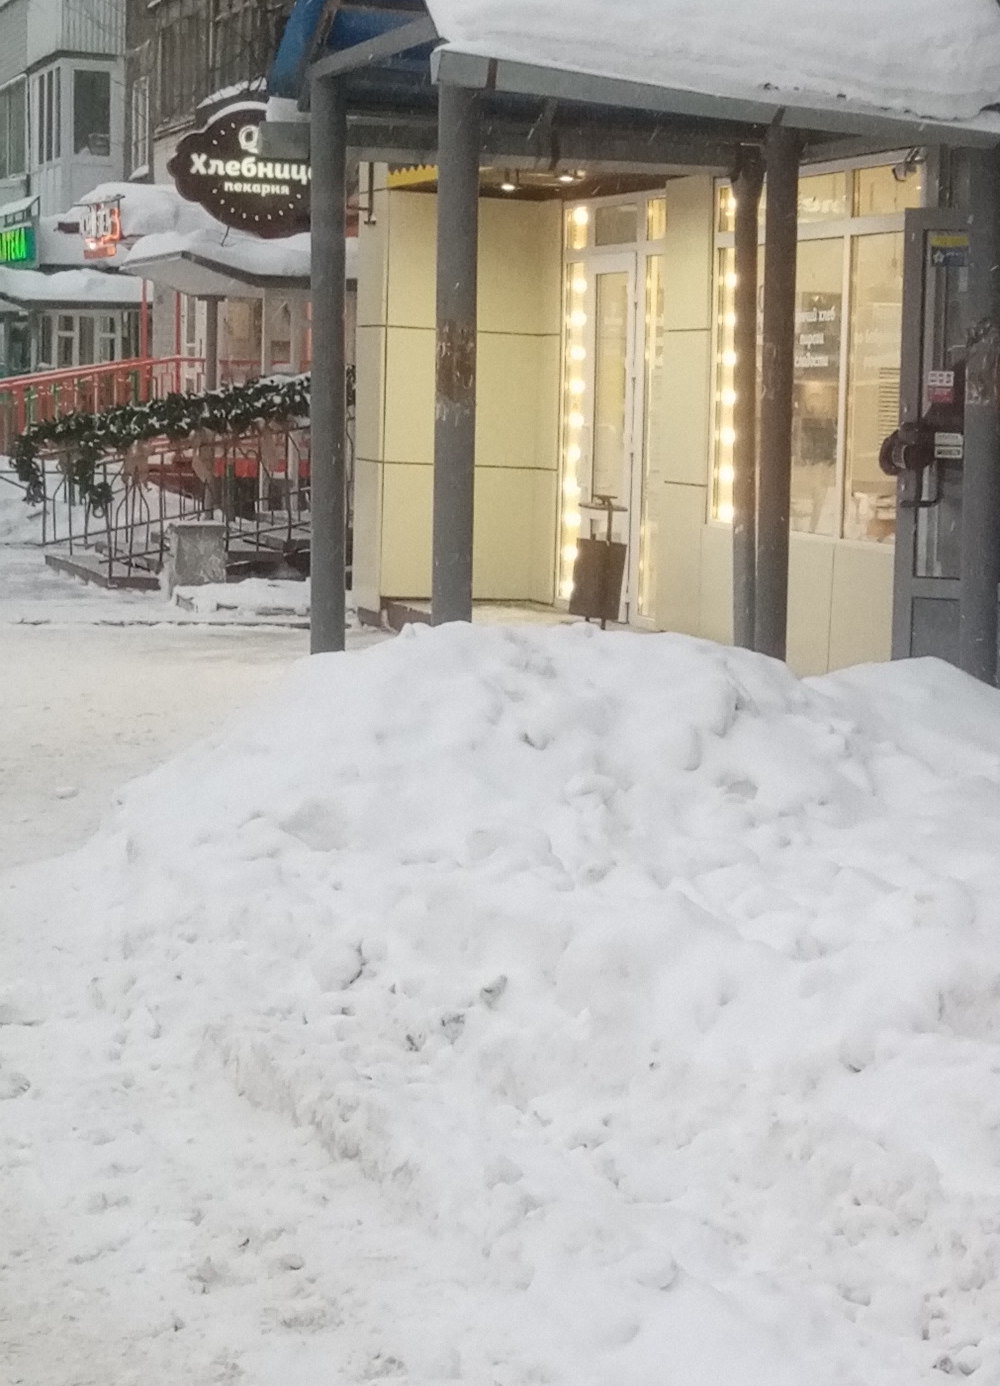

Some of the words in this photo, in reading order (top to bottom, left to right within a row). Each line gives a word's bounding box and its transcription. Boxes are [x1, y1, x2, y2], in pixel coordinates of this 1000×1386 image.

[190, 153, 312, 185] Хлебниц
[224, 181, 290, 197] пекарня
[0, 227, 27, 262] ПТЕКА
